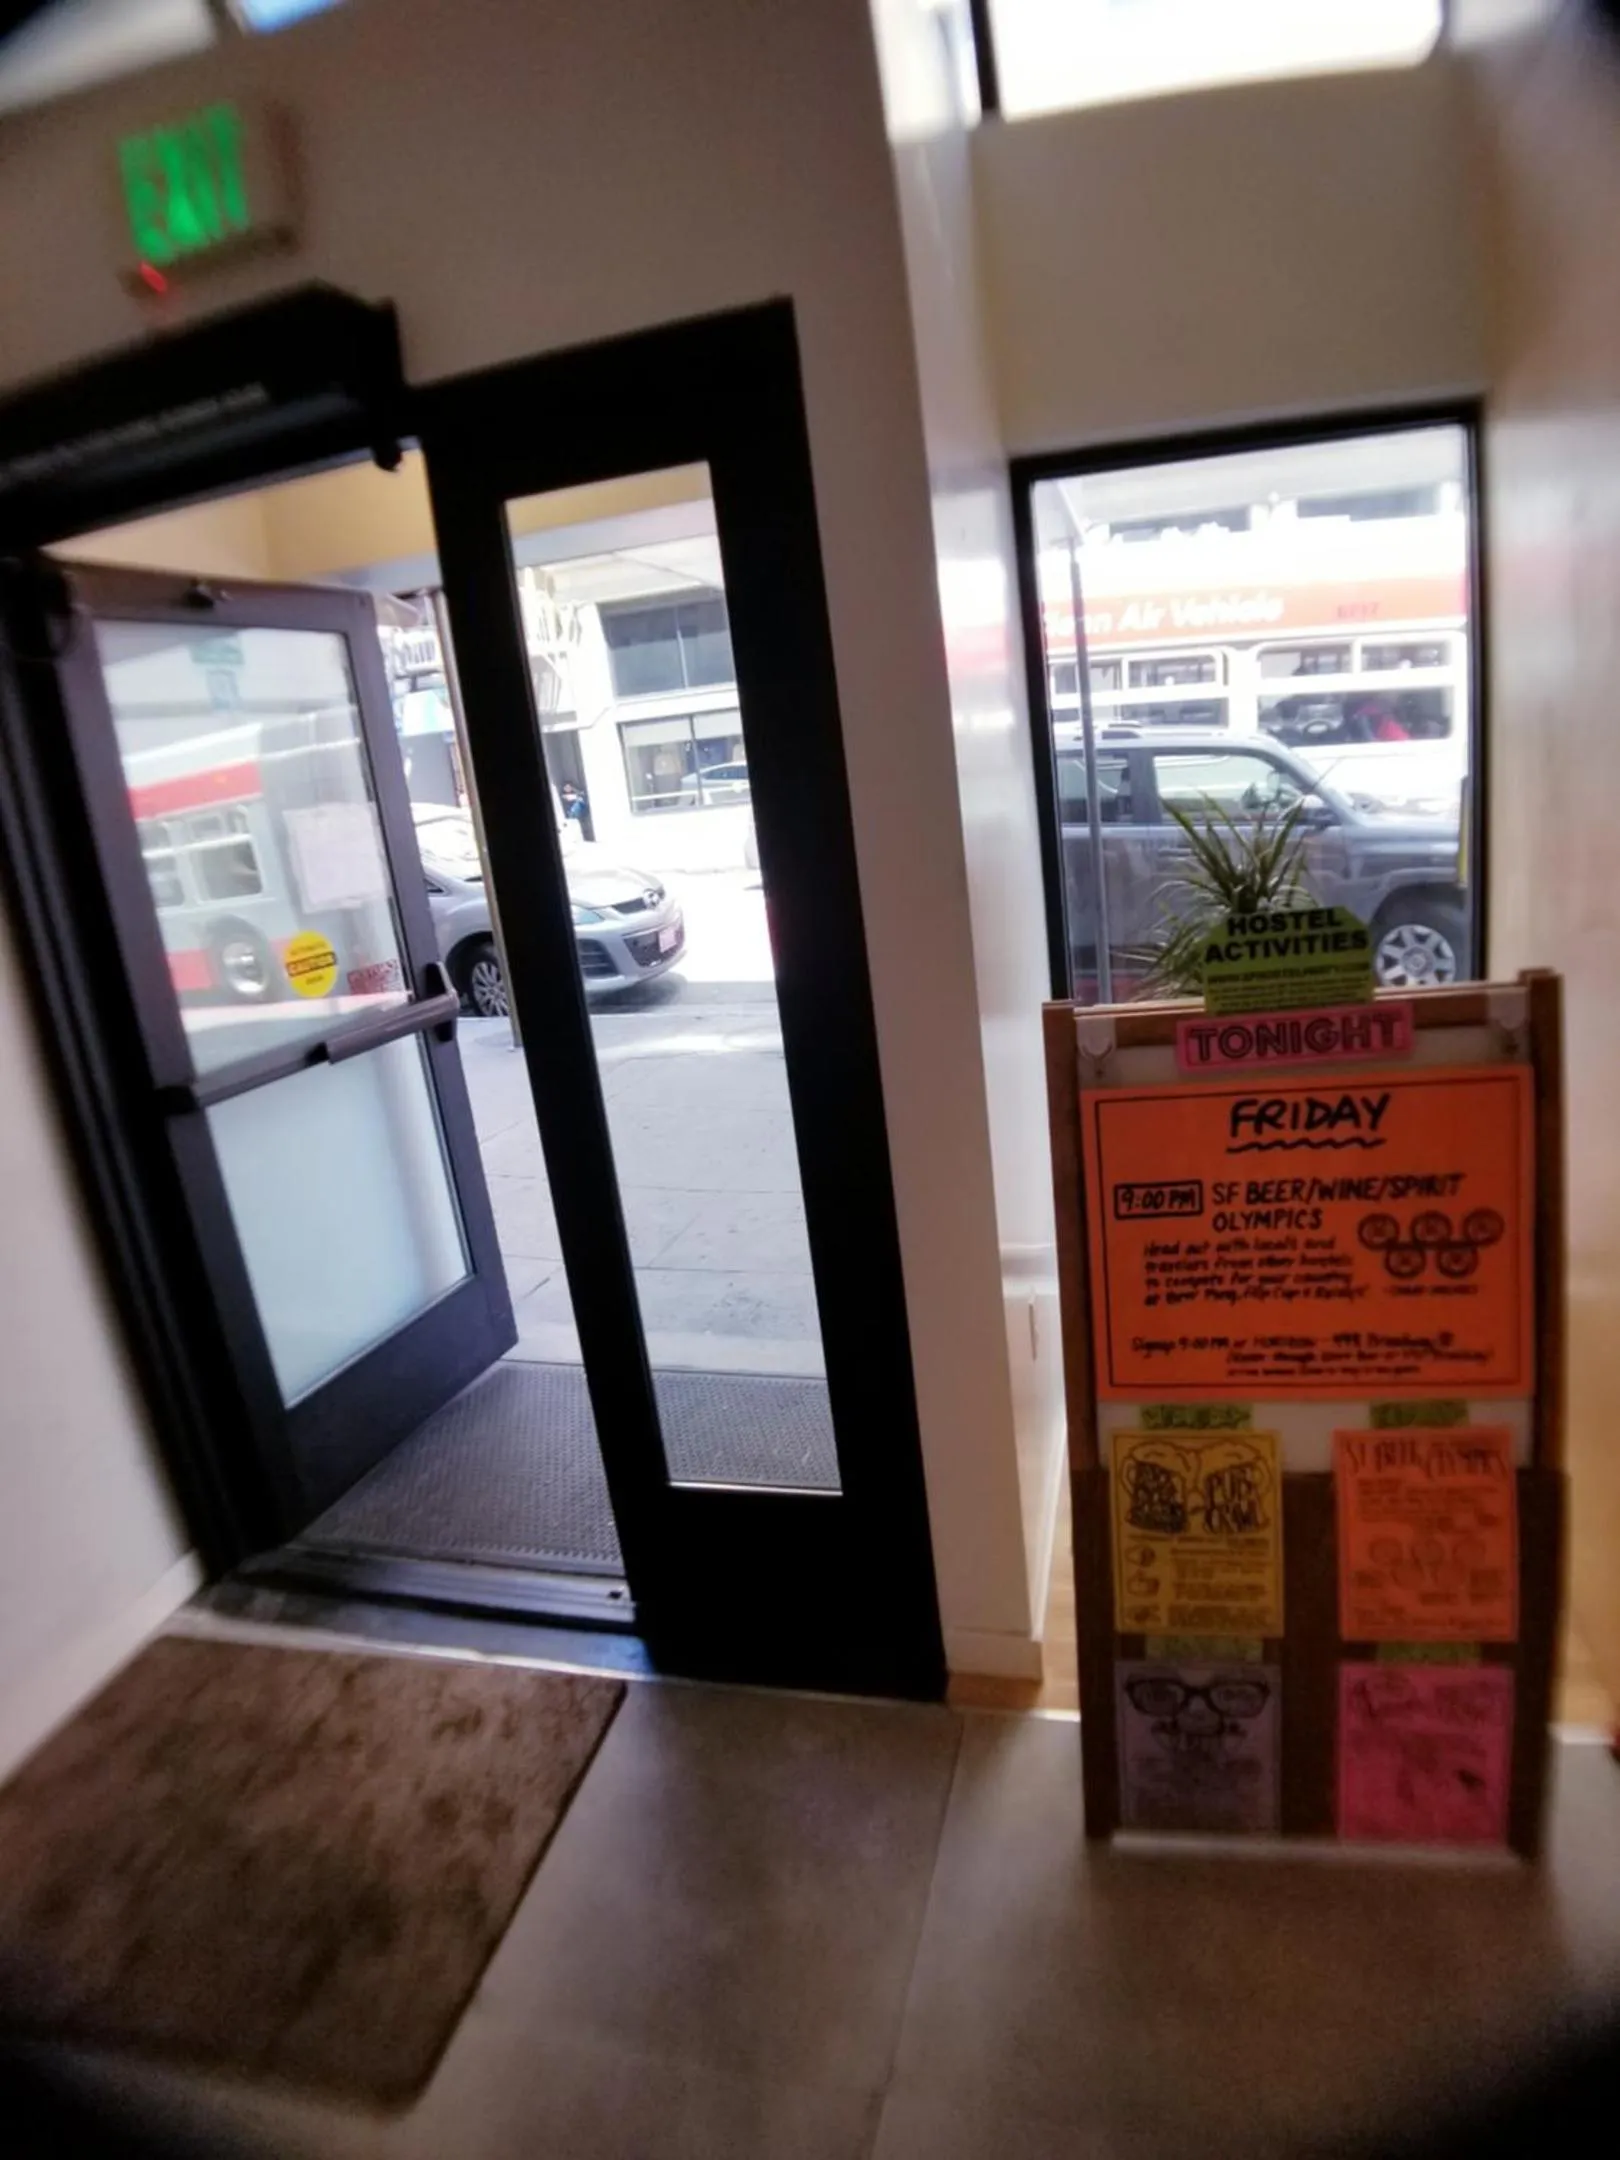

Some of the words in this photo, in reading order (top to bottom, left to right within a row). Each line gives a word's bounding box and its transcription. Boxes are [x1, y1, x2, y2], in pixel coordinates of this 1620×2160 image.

[119, 103, 250, 264] EXIT
[1118, 602, 1164, 630] Air
[1171, 590, 1283, 626] Vehicle
[1227, 907, 1342, 936] HOSTEL
[1204, 930, 1369, 965] ACTIVITIES
[1189, 1013, 1401, 1062] TONIGHT
[1230, 1093, 1391, 1138] FRIDAY
[1121, 1189, 1164, 1212] 9:00
[1168, 1188, 1195, 1209] PM
[1212, 1182, 1239, 1204] SF
[1246, 1173, 1464, 1204] BEER/WINE/SPIRIT
[1213, 1209, 1323, 1232] OLYMPICS
